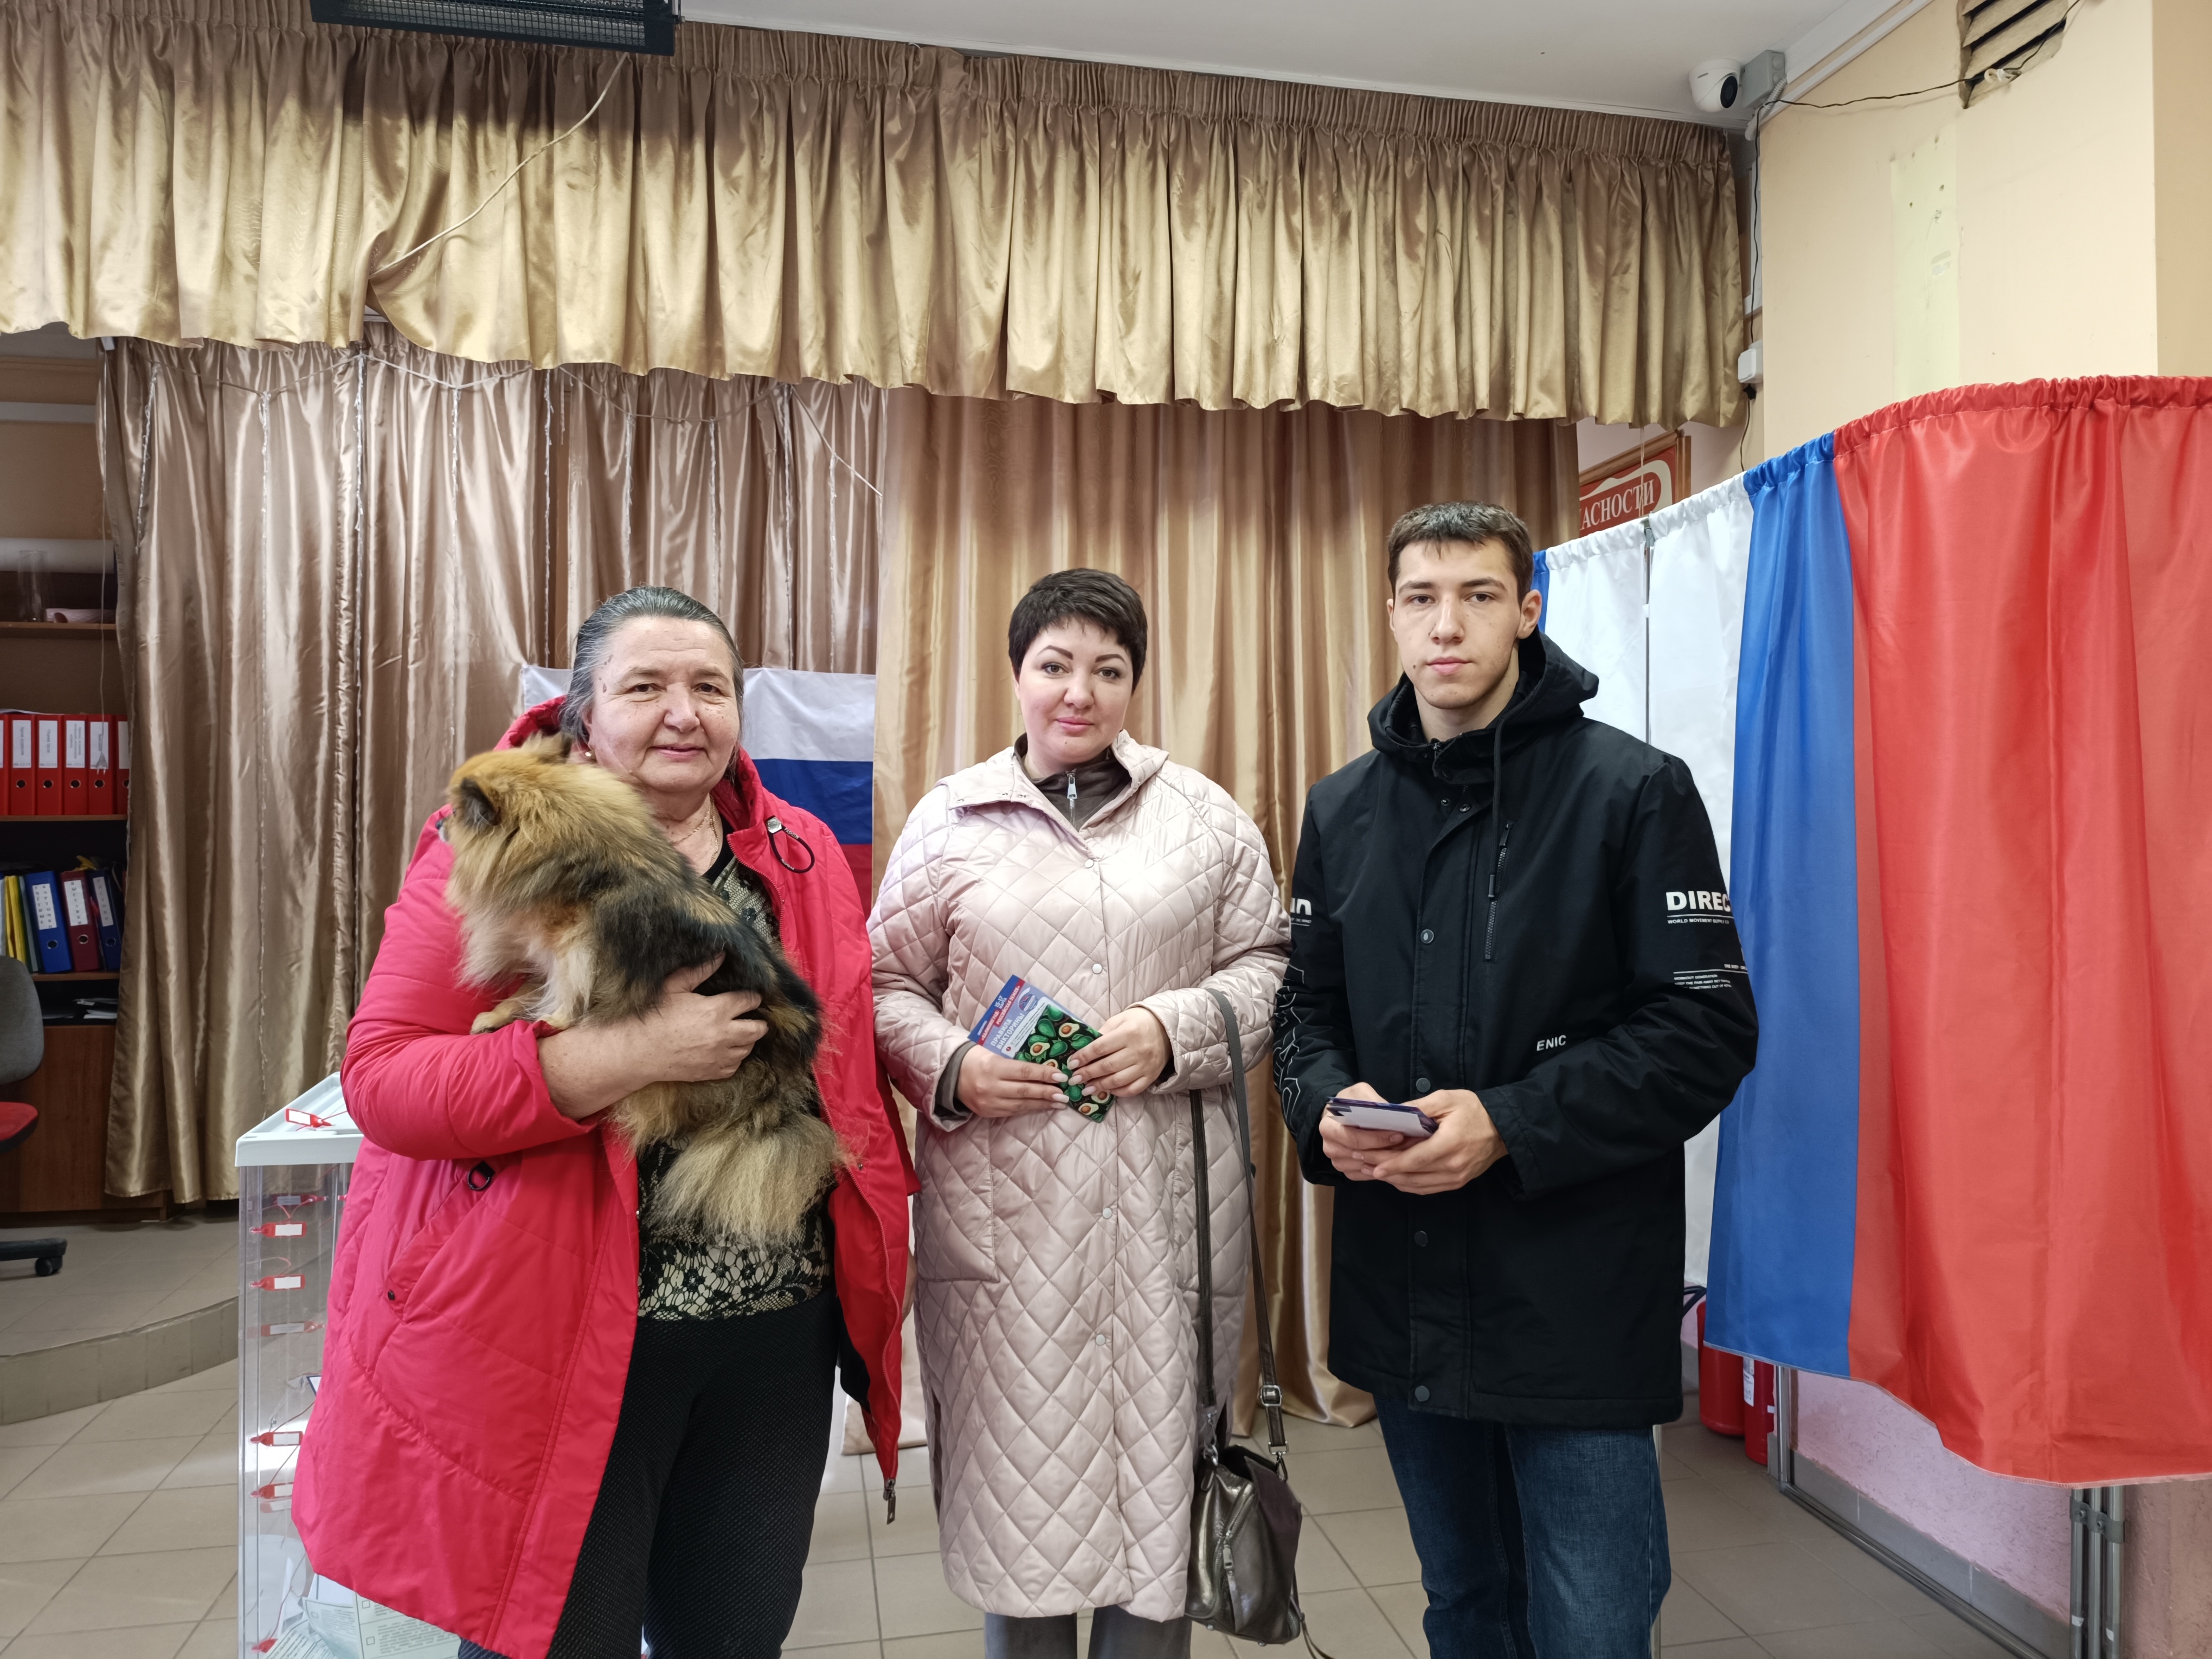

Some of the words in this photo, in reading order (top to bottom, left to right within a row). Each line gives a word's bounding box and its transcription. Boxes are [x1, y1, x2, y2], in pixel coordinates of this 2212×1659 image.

[1579, 479, 1654, 530] АСНОСТИ
[991, 1019, 1013, 1046] ПРАВИЛА
[996, 1013, 1025, 1050] ВИКТОРИНЫ
[1536, 1034, 1566, 1051] ENIC
